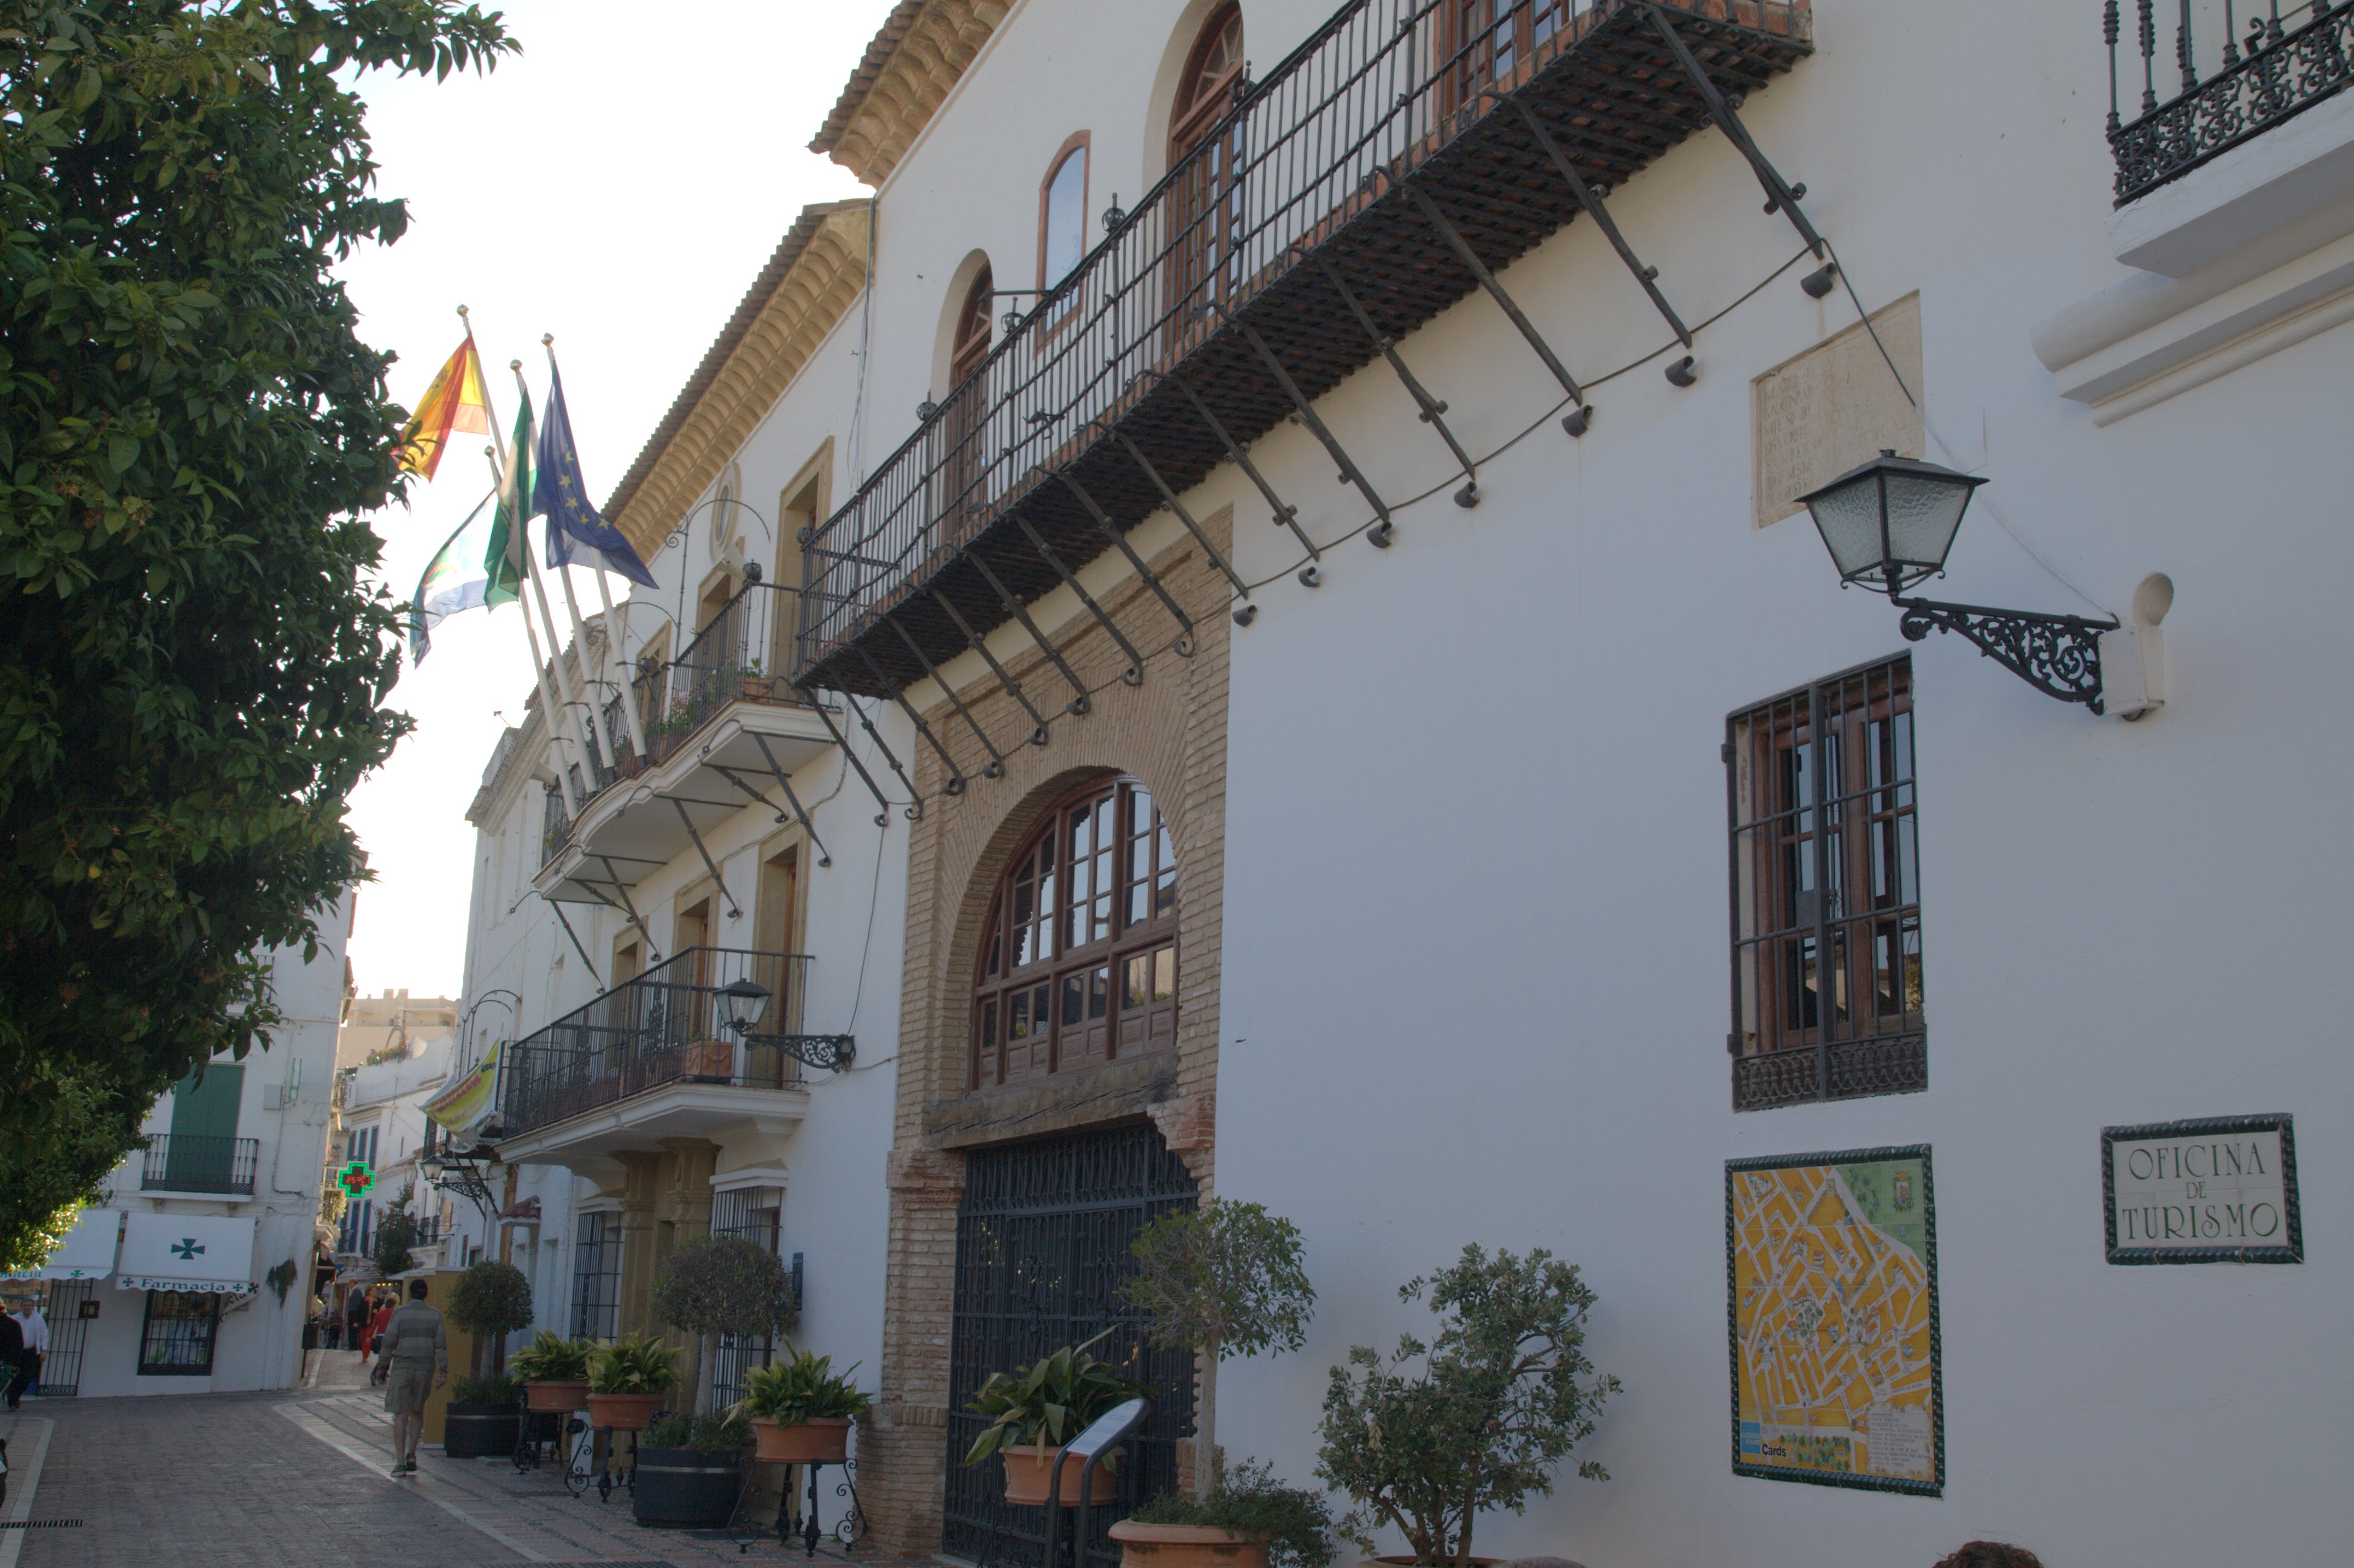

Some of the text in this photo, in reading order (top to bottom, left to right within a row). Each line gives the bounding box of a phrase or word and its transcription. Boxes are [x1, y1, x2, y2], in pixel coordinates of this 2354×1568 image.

[2129, 1141, 2266, 1180] OFICINA
[2185, 1181, 2206, 1199] DE
[2123, 1203, 2278, 1240] TURISMO
[141, 1278, 225, 1291] Farmacia
[1762, 1443, 1786, 1458] Cards
